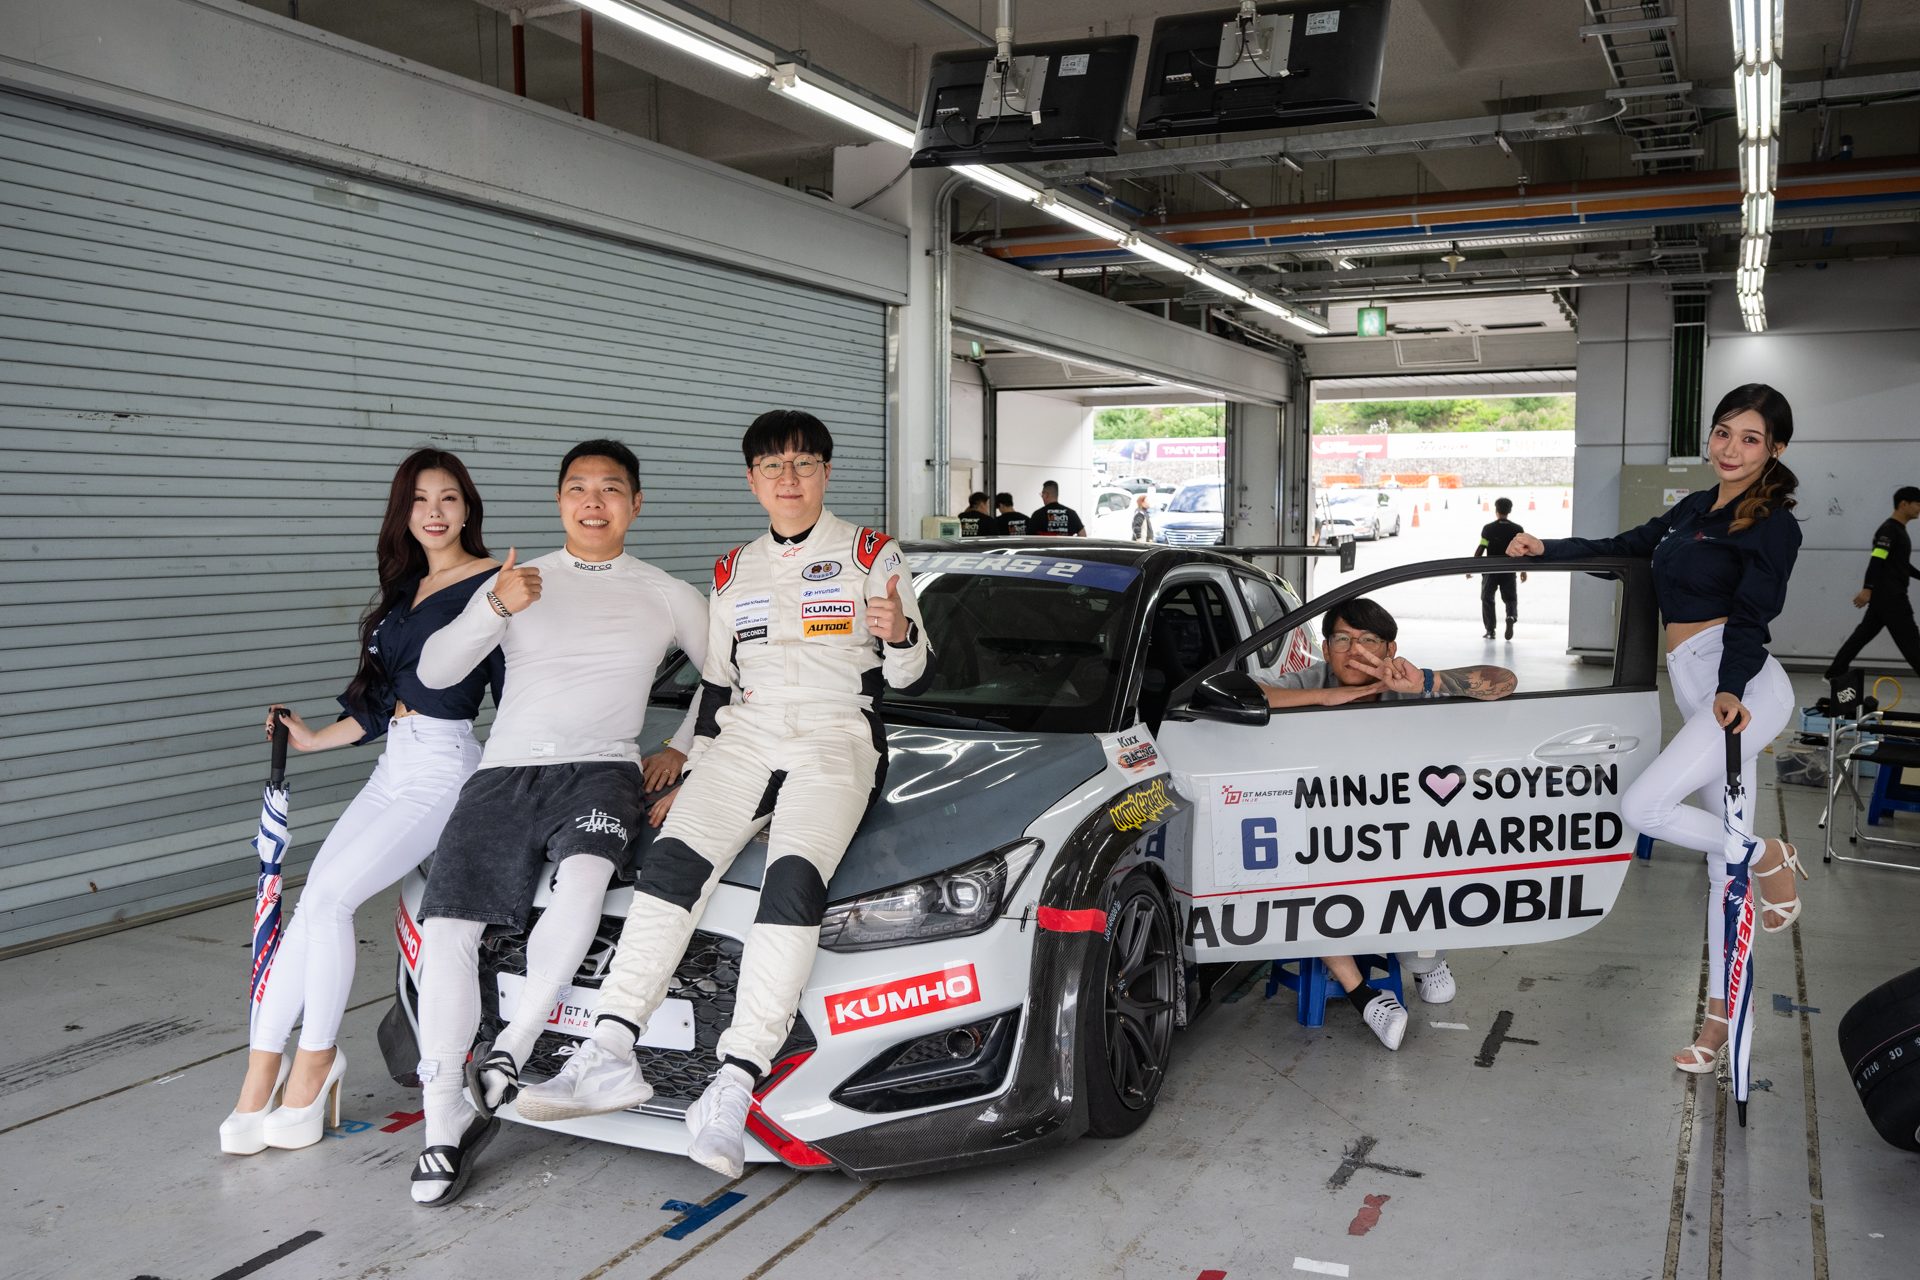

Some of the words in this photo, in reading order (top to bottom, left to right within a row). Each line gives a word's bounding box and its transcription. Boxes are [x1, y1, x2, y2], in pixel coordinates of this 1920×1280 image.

[574, 561, 612, 571] sparco
[1045, 562, 1083, 578] 2
[814, 587, 841, 595] HYUNDAI
[804, 605, 852, 613] KUMHO
[1117, 735, 1140, 748] Kixx
[1122, 744, 1157, 764] RACING
[1254, 789, 1294, 797] MASTERS
[1294, 772, 1411, 809] MINJE
[1472, 764, 1619, 800] SOYEON
[1241, 817, 1278, 870] 6
[1295, 823, 1410, 865] JUST
[1424, 811, 1623, 858] MARRIED
[1186, 894, 1365, 948] AUTO
[1380, 874, 1604, 935] MOBIL
[396, 906, 418, 960] UMHO
[834, 975, 972, 1024] KUMHO
[564, 1005, 582, 1017] GT
[563, 1017, 589, 1027] INJE
[1888, 1047, 1904, 1060] 3D
